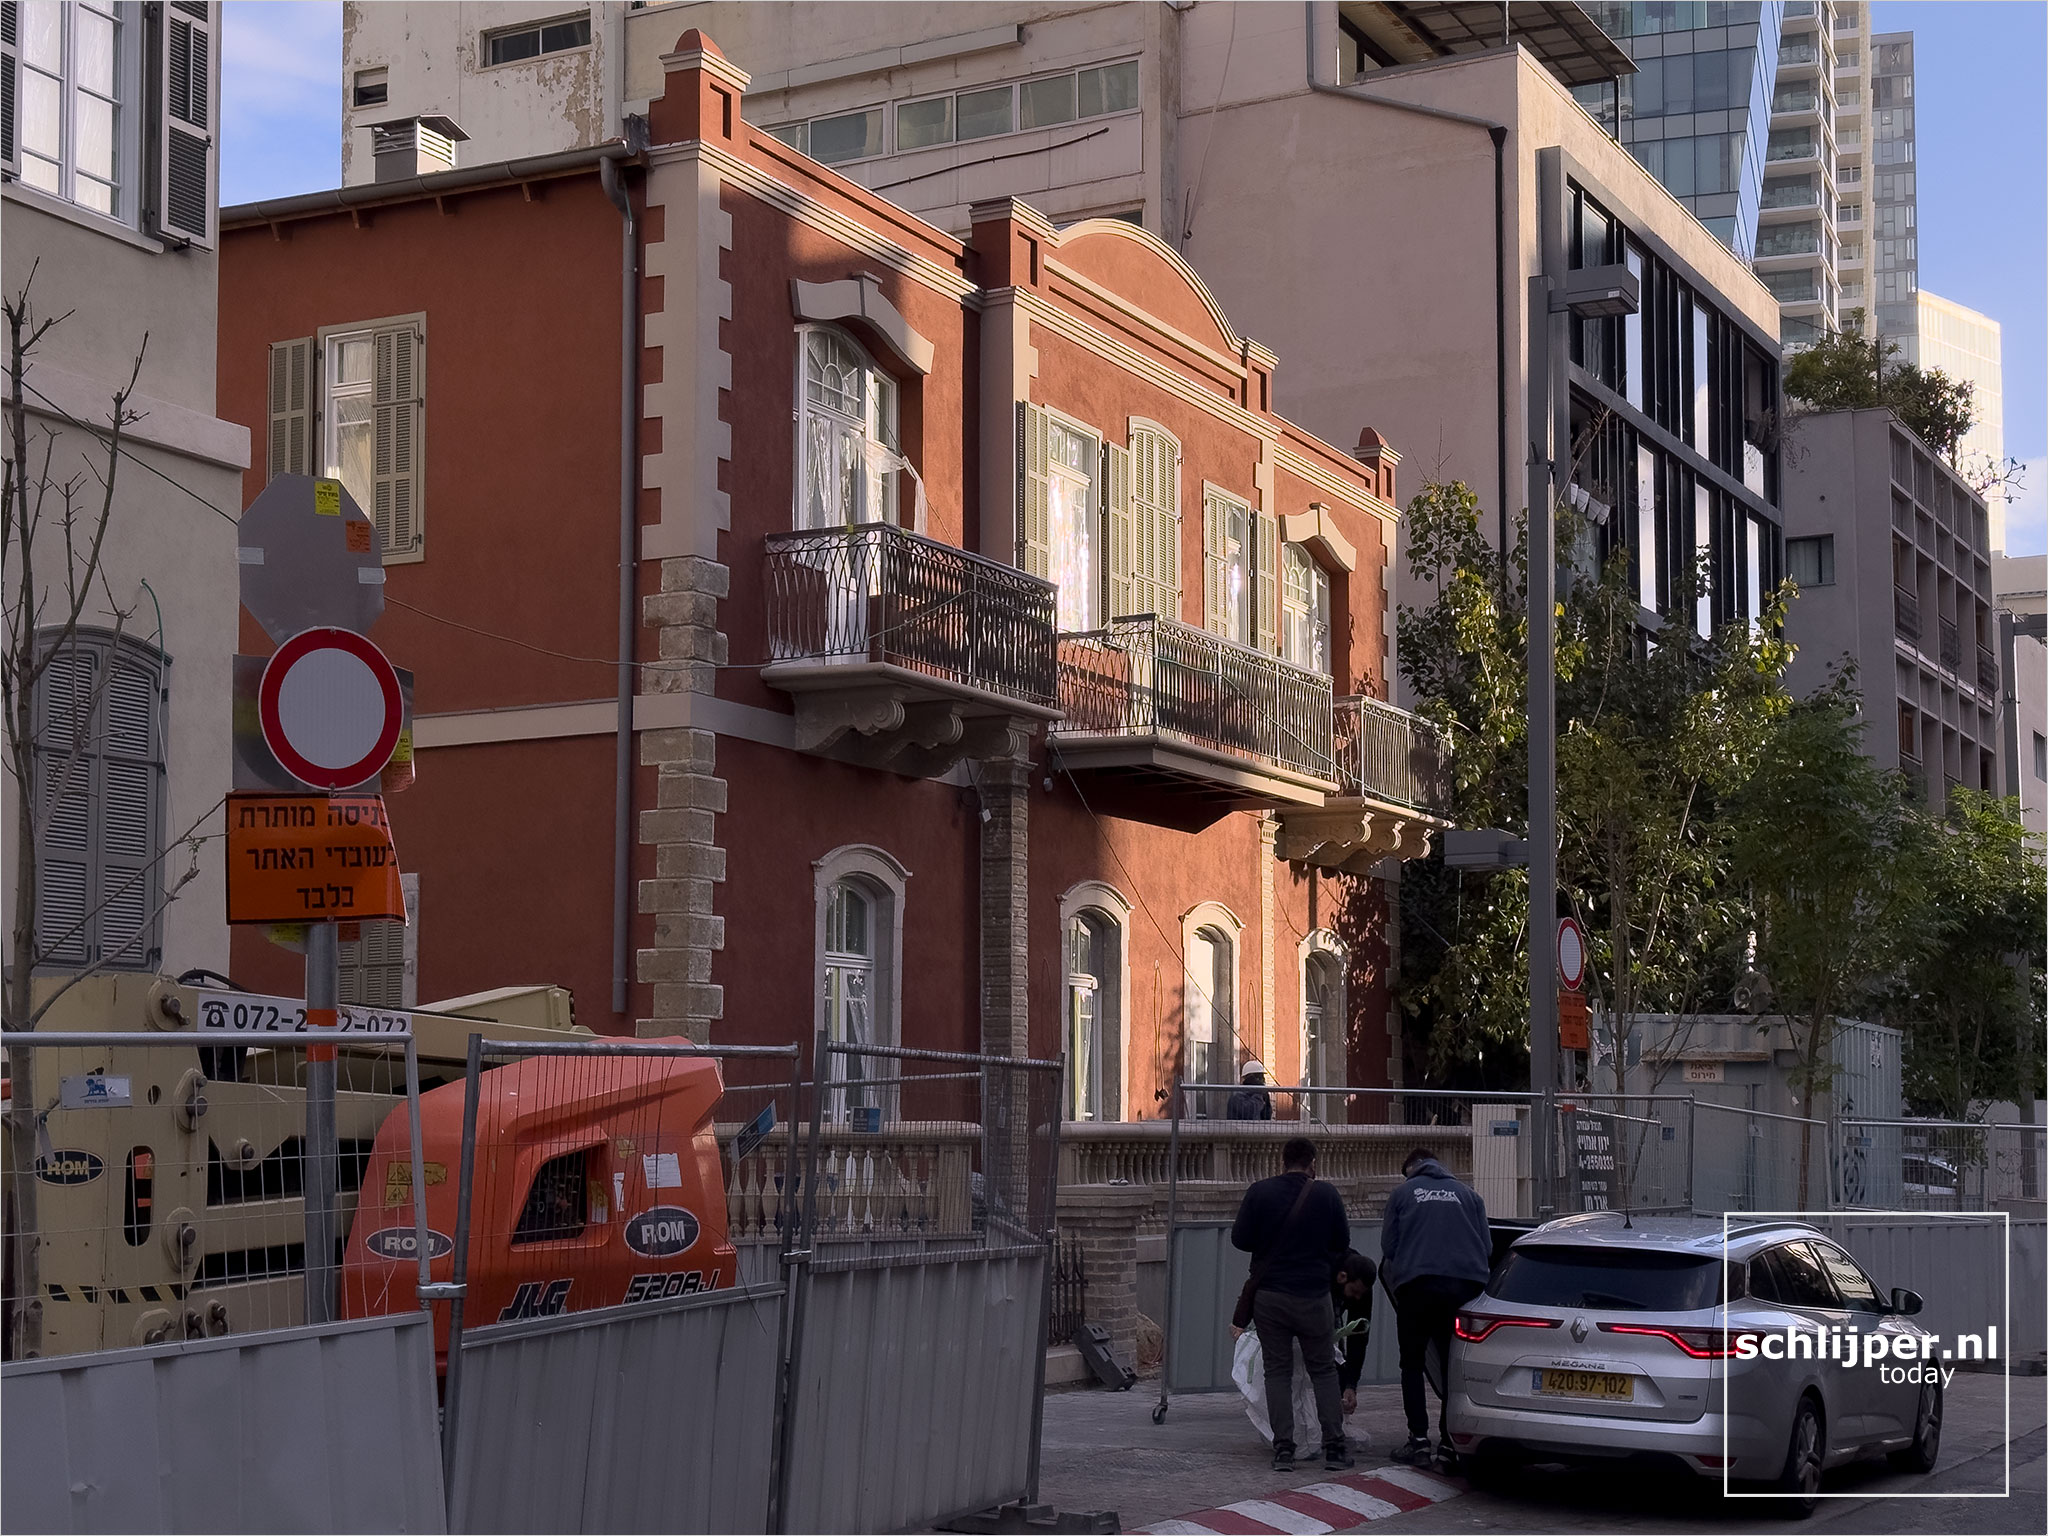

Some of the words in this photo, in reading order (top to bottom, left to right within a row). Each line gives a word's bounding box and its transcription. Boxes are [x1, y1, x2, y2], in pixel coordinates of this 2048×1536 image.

[239, 806, 315, 828] מותרת
[246, 847, 314, 870] האתר
[296, 883, 354, 909] בלבד
[1690, 1071, 1716, 1080] חירום
[47, 1160, 89, 1176] ROM
[641, 1220, 685, 1245] ROM
[496, 1278, 574, 1323] JLG
[1551, 1359, 1606, 1371] MEGANE
